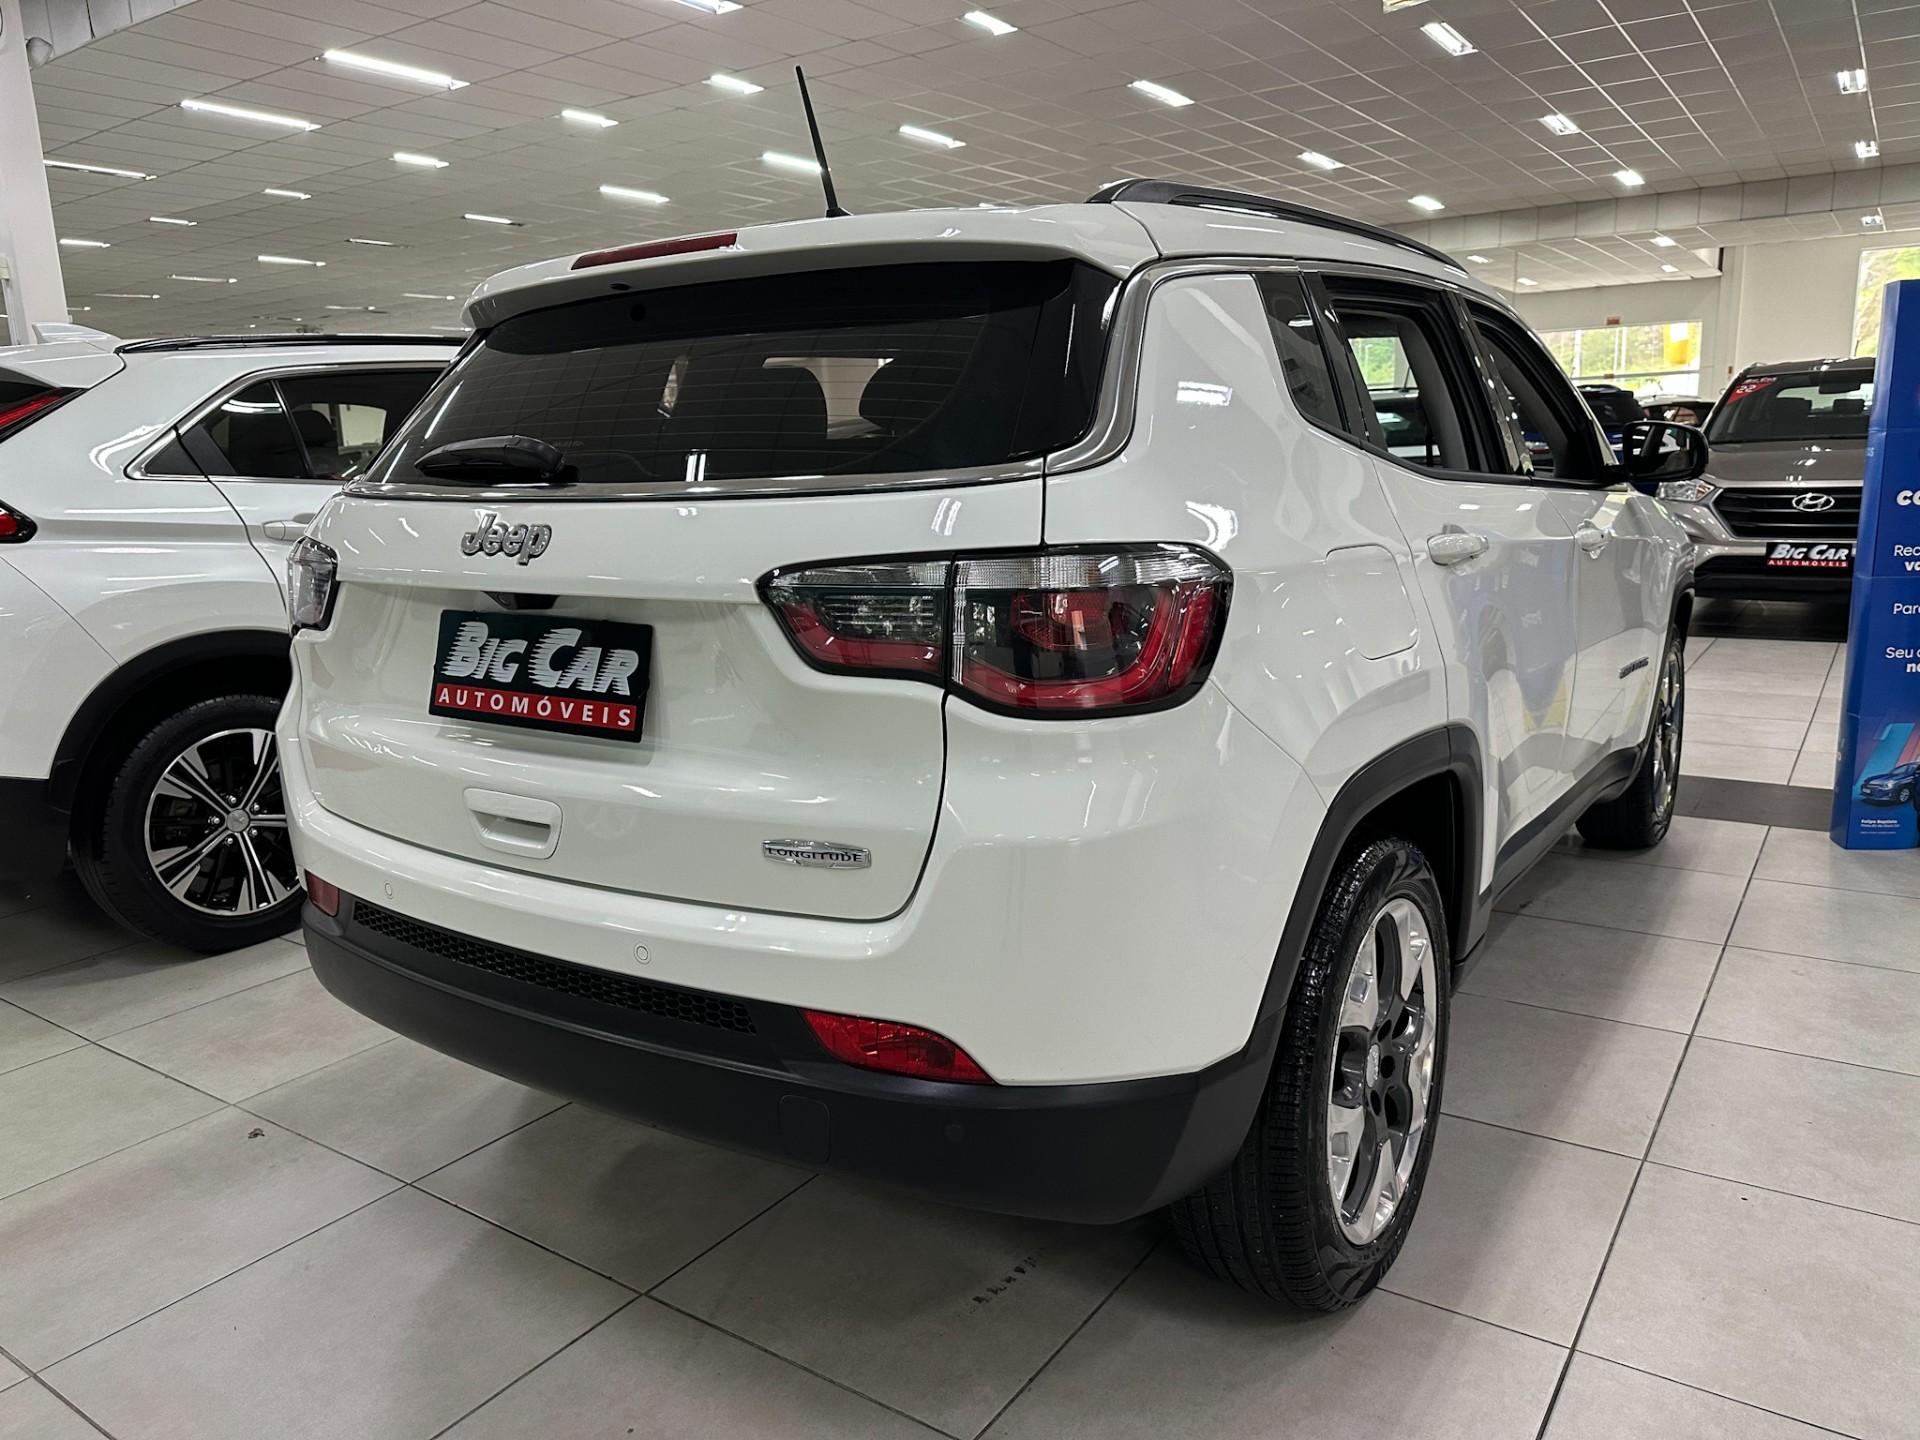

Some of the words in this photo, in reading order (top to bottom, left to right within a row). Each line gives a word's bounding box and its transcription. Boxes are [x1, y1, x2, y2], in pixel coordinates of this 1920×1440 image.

[461, 513, 552, 566] Jeep
[441, 621, 528, 683] BIG
[528, 628, 640, 696] CAR
[1885, 646, 1914, 659] Seu
[438, 687, 632, 727] AUTOMÓVEIS
[768, 847, 862, 862] LONGITUDE
